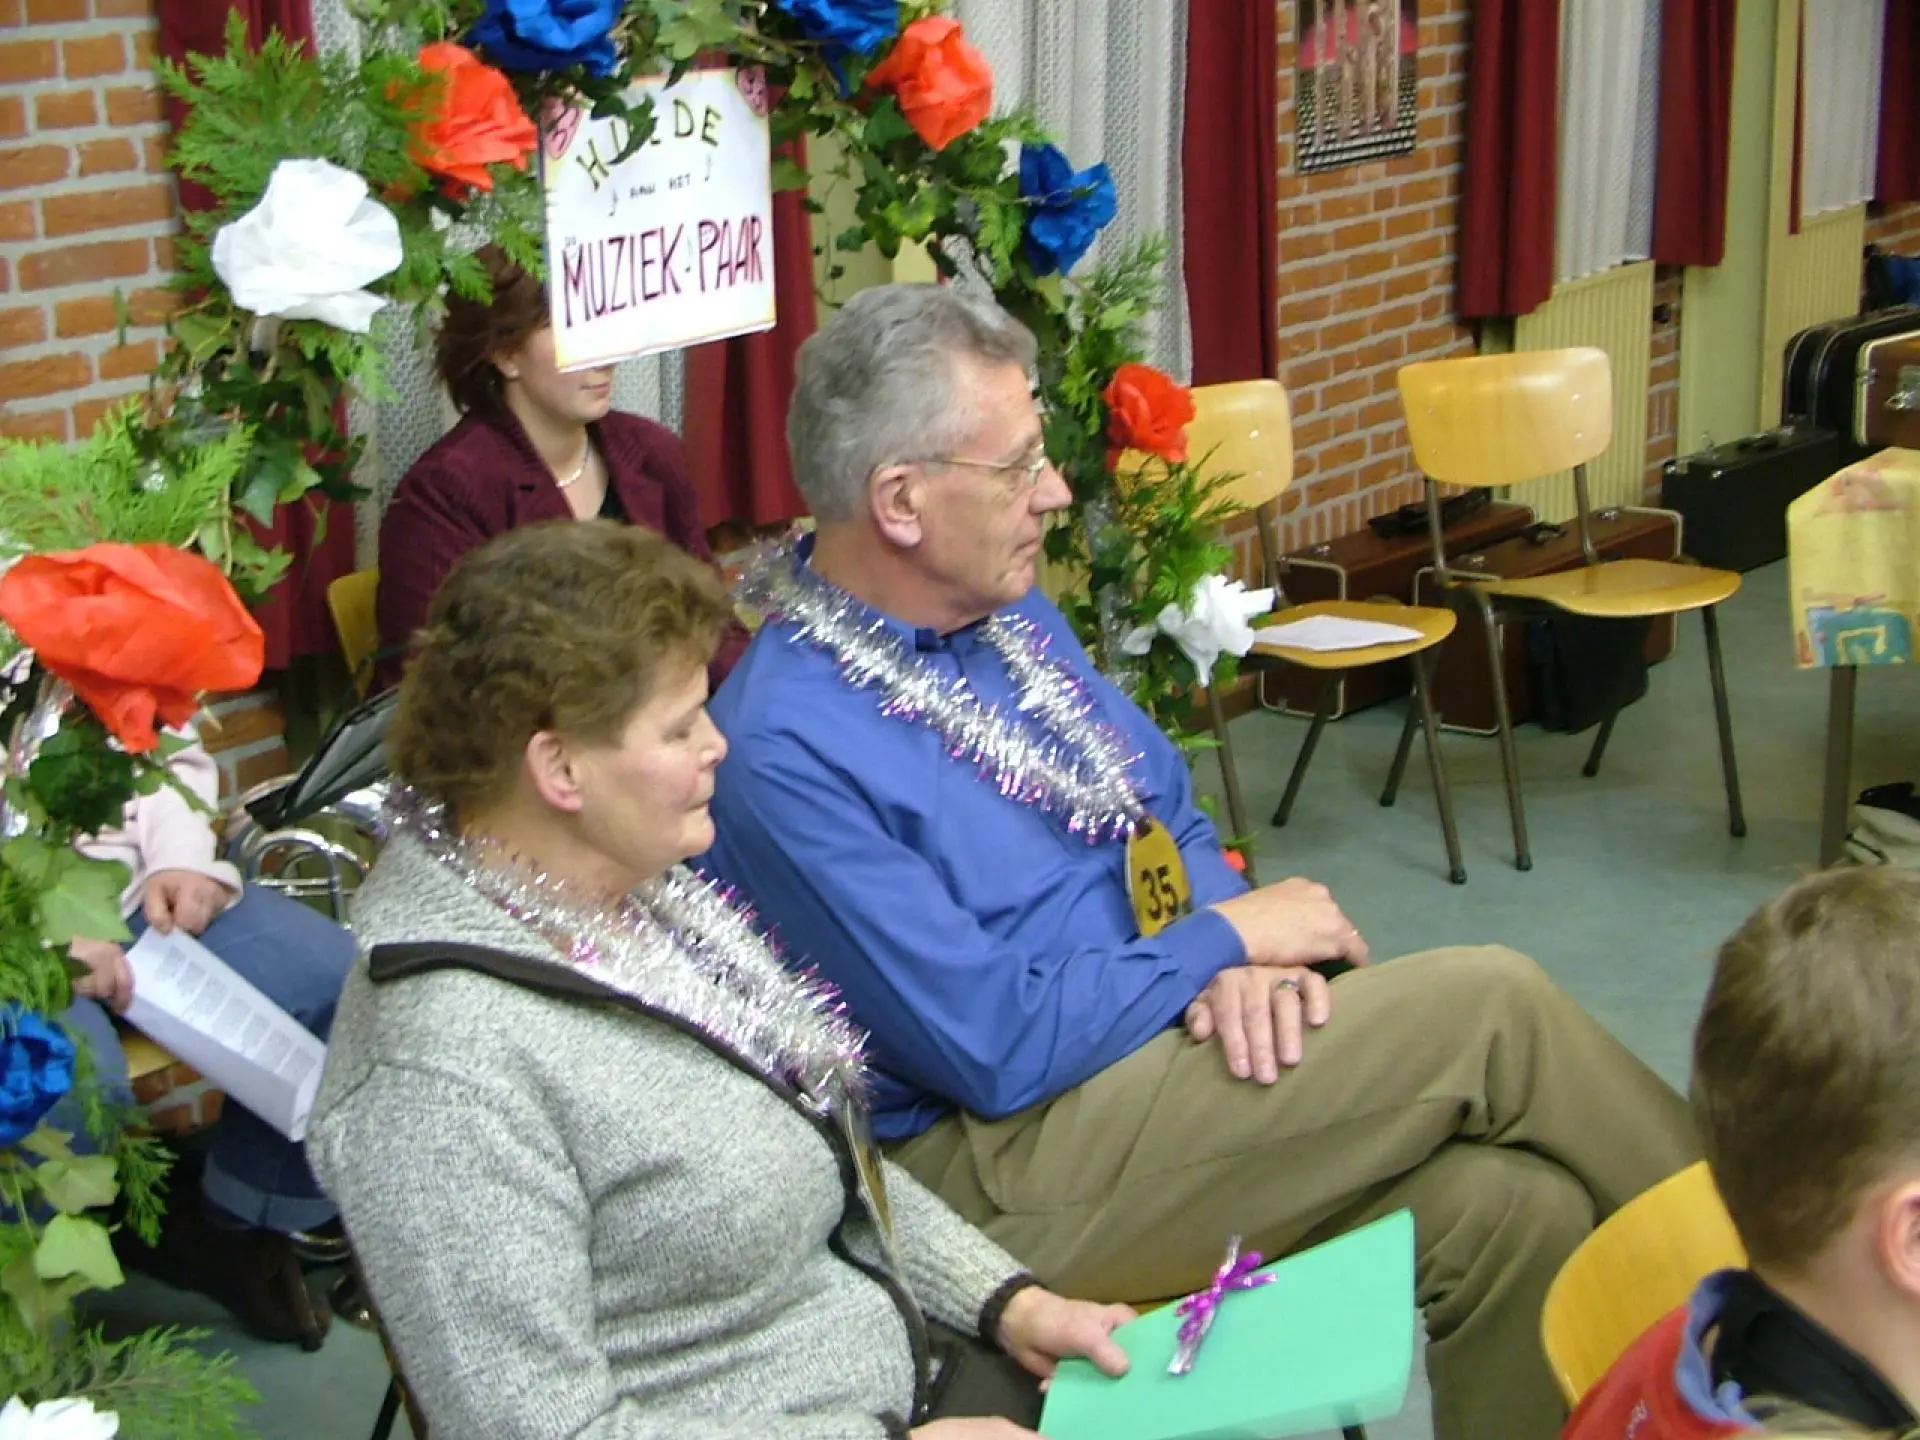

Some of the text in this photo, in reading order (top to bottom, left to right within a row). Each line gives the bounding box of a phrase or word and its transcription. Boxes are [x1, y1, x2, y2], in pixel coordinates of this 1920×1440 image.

[576, 98, 722, 192] HDE
[669, 173, 691, 190] HET
[561, 215, 763, 328] MUZIEK PAAR
[1141, 864, 1179, 920] 35
